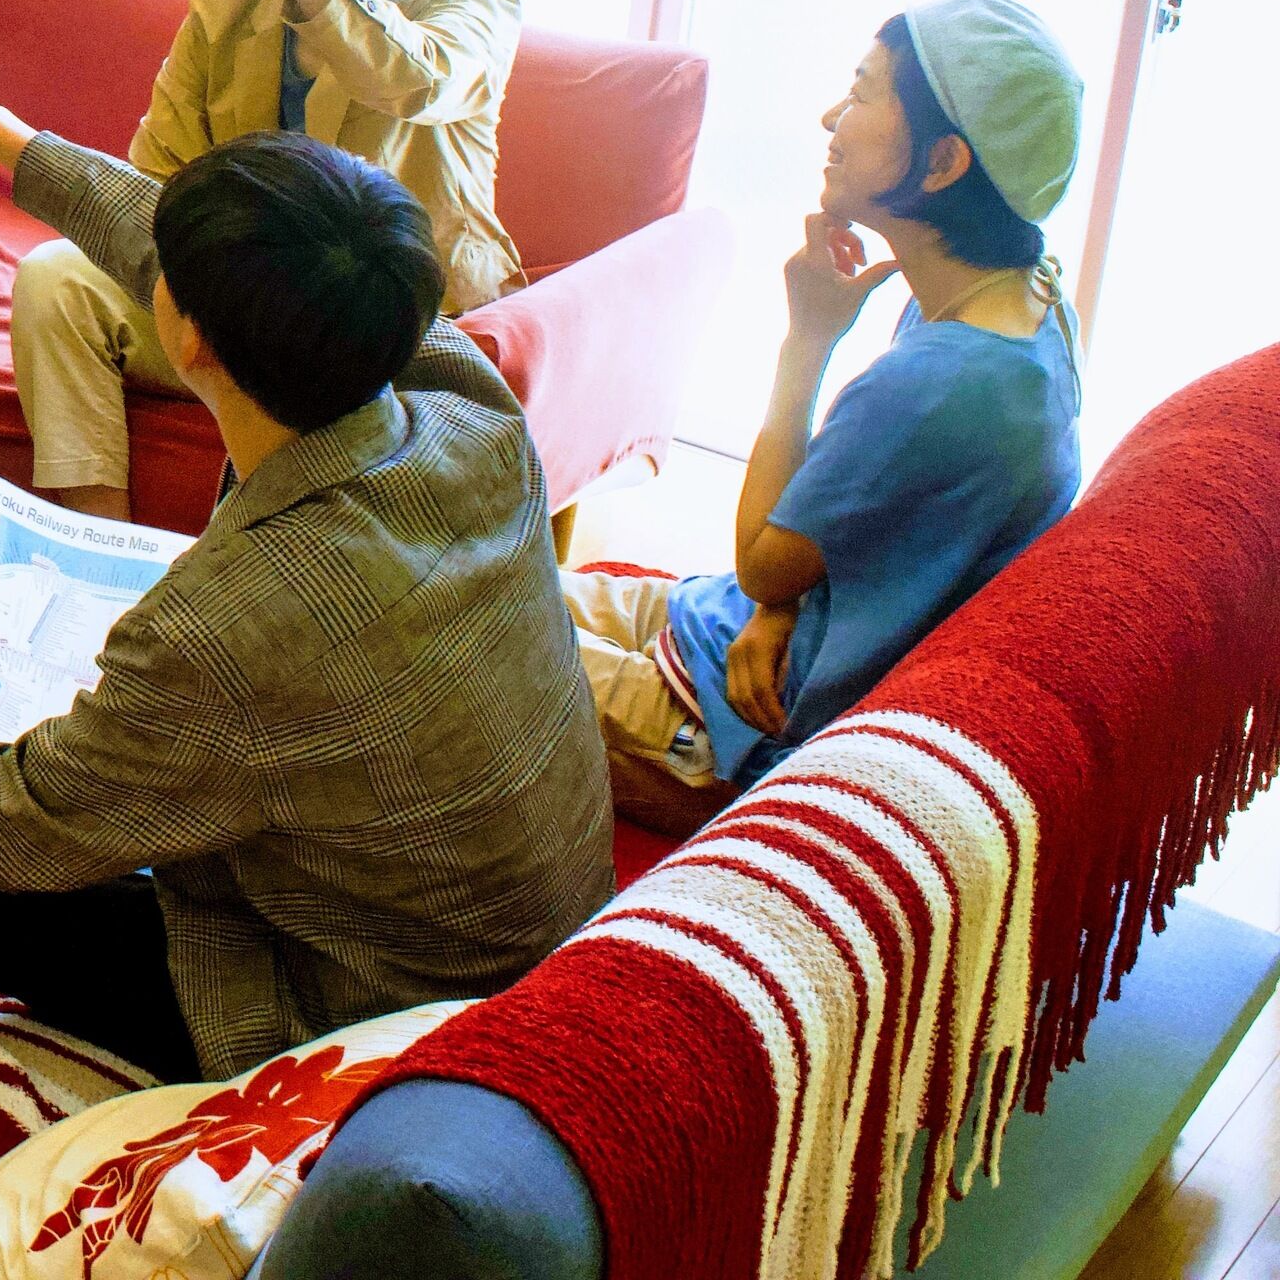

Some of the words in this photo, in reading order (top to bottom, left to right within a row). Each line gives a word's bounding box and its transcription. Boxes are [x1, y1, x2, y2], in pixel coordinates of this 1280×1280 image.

[26, 507, 79, 538] Railway
[82, 527, 125, 548] Route
[129, 535, 159, 553] Map
